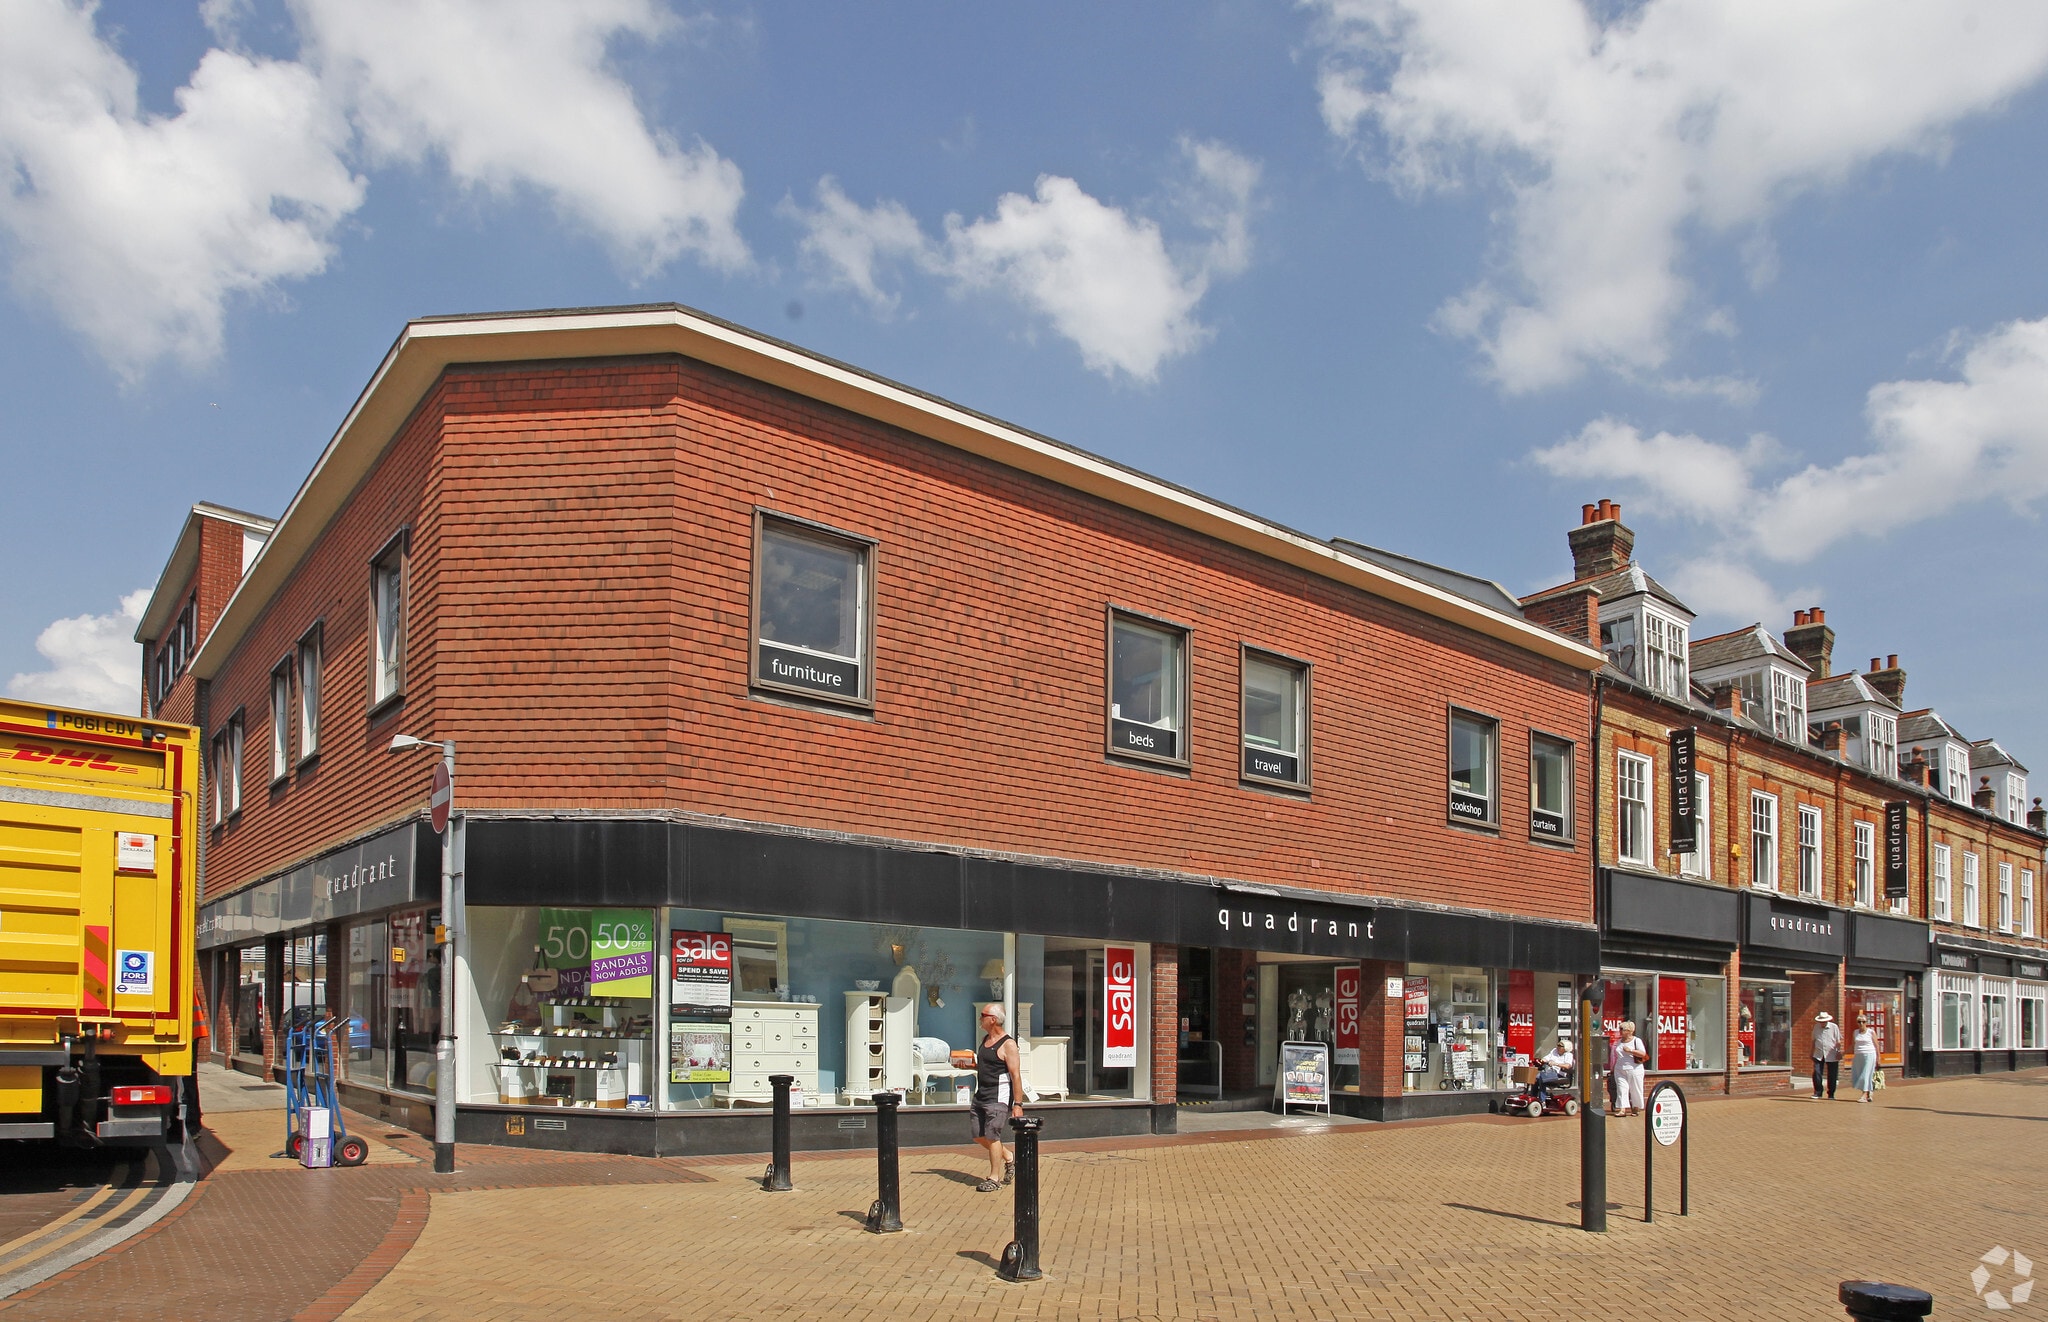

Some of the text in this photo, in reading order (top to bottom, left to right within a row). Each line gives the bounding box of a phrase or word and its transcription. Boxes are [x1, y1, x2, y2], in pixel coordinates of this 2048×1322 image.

[772, 659, 842, 686] furniture
[62, 714, 136, 736] PO61 CDV
[1129, 731, 1154, 748] beds
[12, 743, 120, 771] DHL
[1254, 758, 1282, 774] travel
[1676, 737, 1690, 815] quadrant
[1451, 801, 1482, 817] cookshop
[1533, 819, 1556, 832] curtains
[1889, 808, 1903, 870] quadrant
[326, 854, 396, 901] quadrant
[1218, 908, 1374, 939] quadrant
[1770, 917, 1832, 936] quadrant
[632, 940, 646, 948] OFF
[676, 934, 728, 961] sale
[594, 955, 647, 972] SANDALS
[596, 966, 648, 980] NOW ADDED
[678, 966, 701, 974] SPEND
[1108, 962, 1131, 1030] sale
[1338, 980, 1358, 1035] sale
[1407, 1004, 1427, 1014] SALE
[1510, 1013, 1533, 1027] SALE
[1657, 1015, 1685, 1034] SALE
